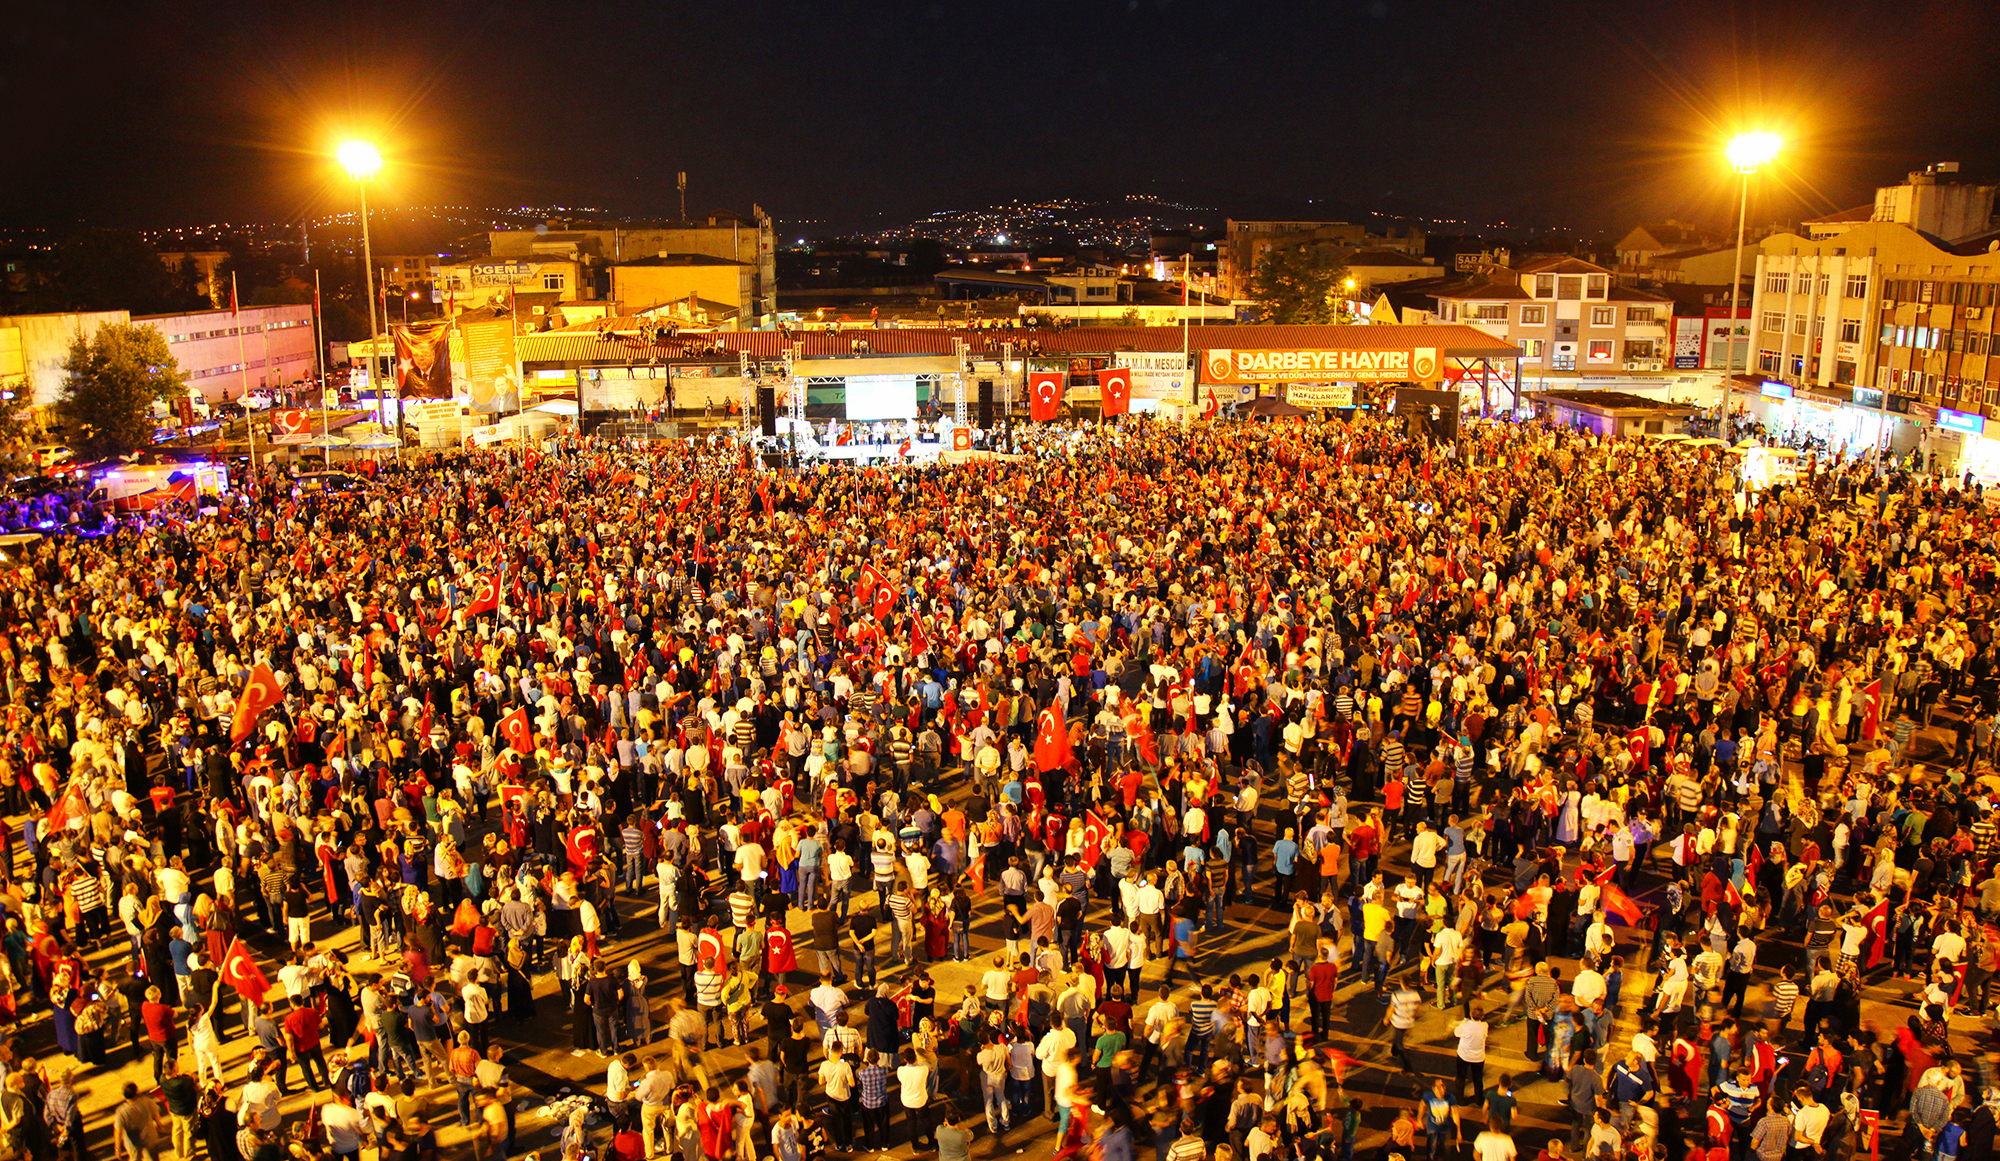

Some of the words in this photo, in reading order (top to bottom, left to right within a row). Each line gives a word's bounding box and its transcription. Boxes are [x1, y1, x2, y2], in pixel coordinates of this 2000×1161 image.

[1155, 355, 1184, 369] MESCİDİ
[1238, 352, 1337, 369] DARBEYE
[1341, 351, 1409, 369] HAYIR!
[1289, 372, 1321, 380] DÜŞÜNCE
